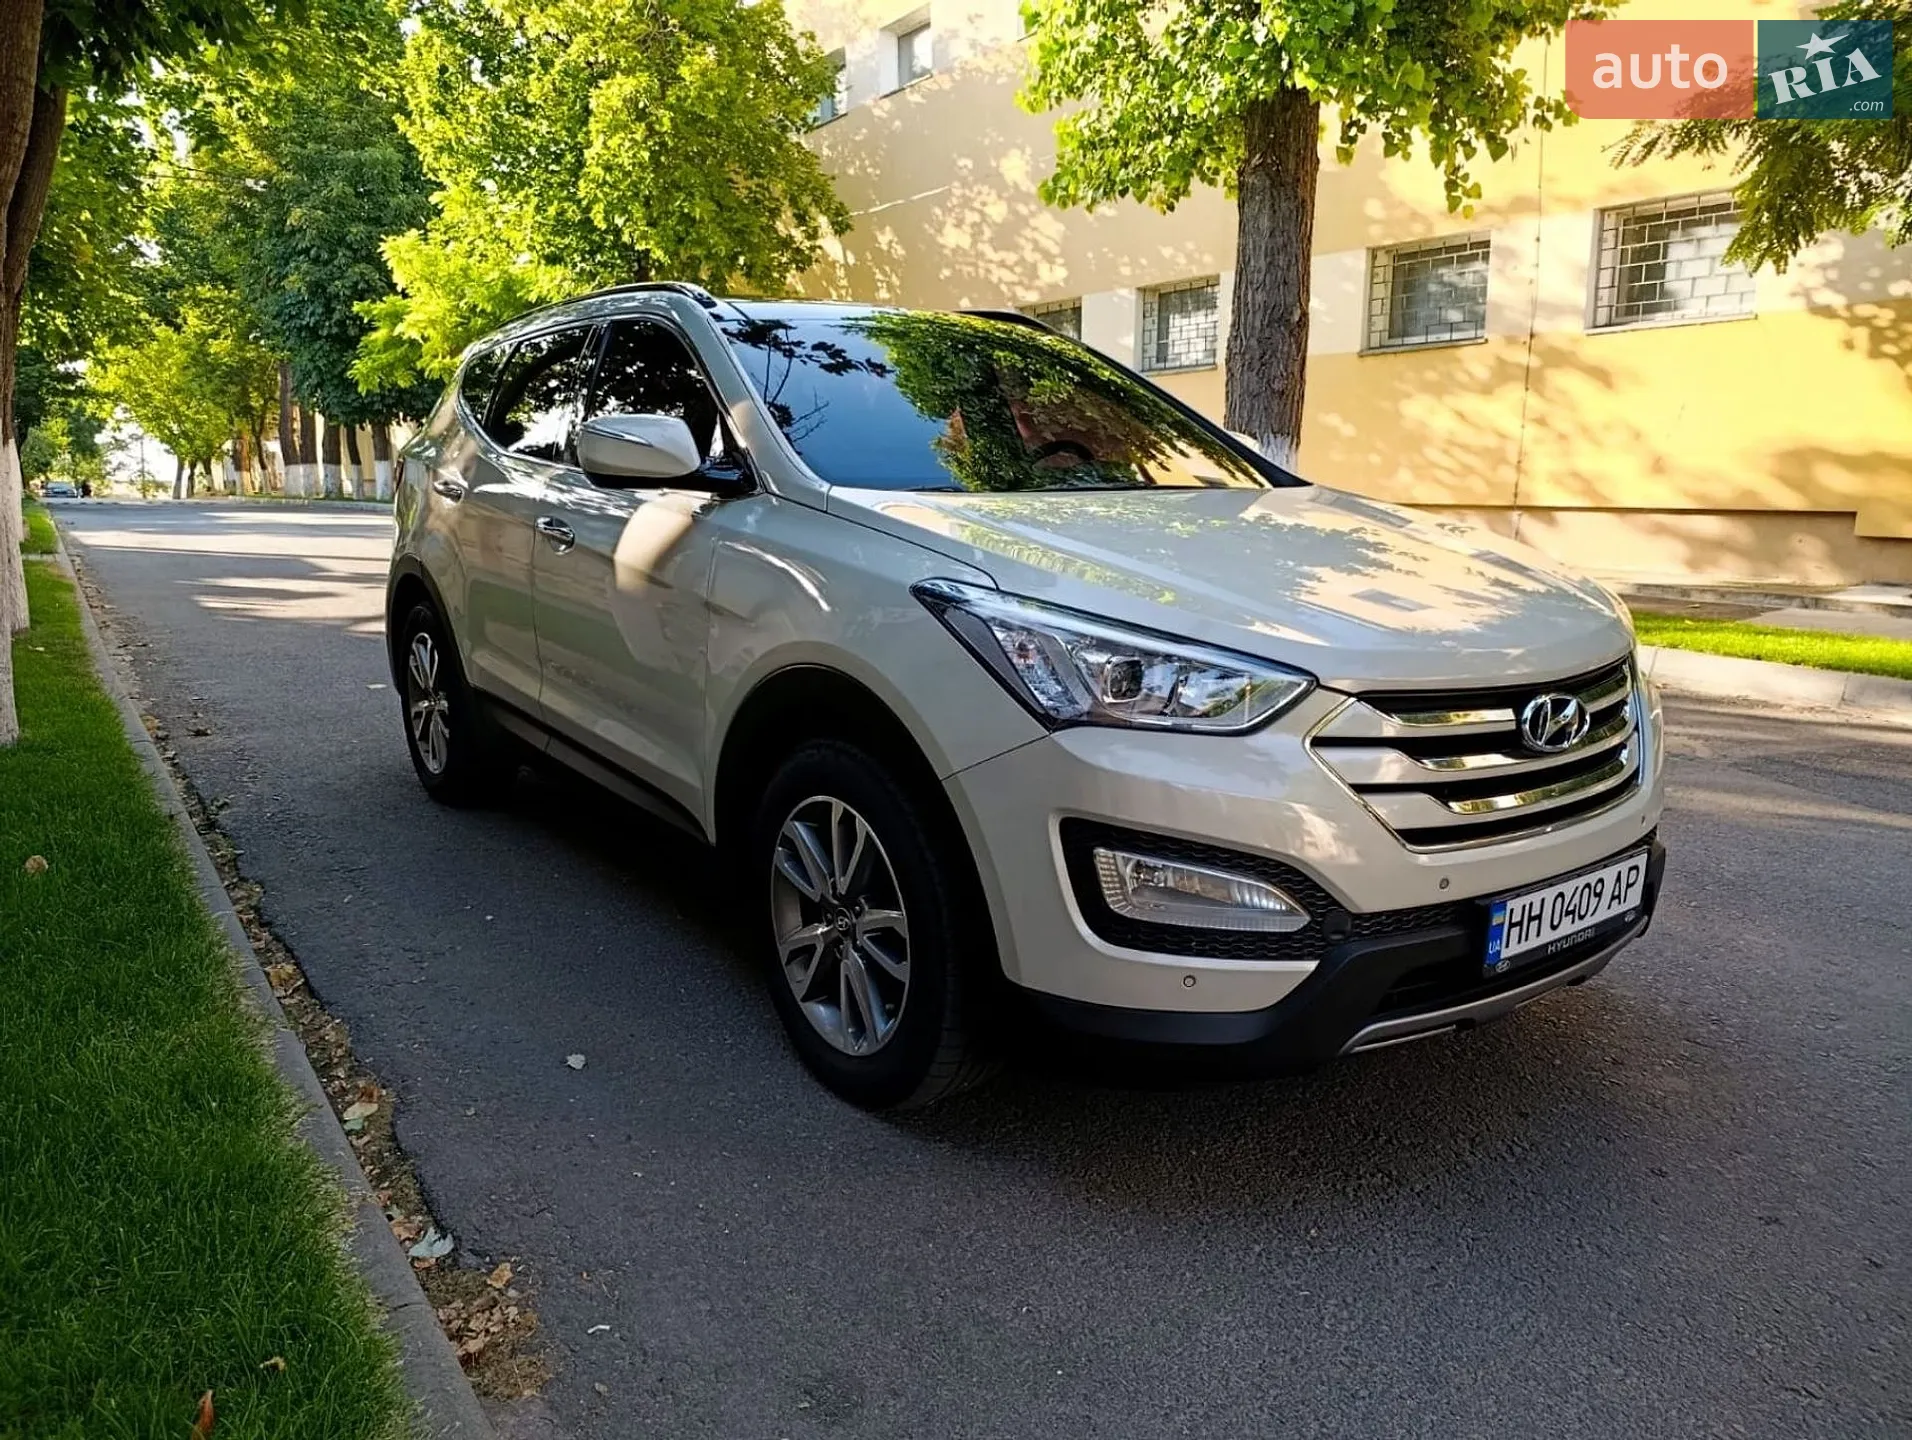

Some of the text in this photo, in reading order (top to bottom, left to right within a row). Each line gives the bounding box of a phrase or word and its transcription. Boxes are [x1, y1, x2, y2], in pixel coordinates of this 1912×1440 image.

[1505, 865, 1640, 949] HH 0409 AP
[1488, 940, 1501, 954] UA
[1547, 927, 1596, 955] HYUNDAI
